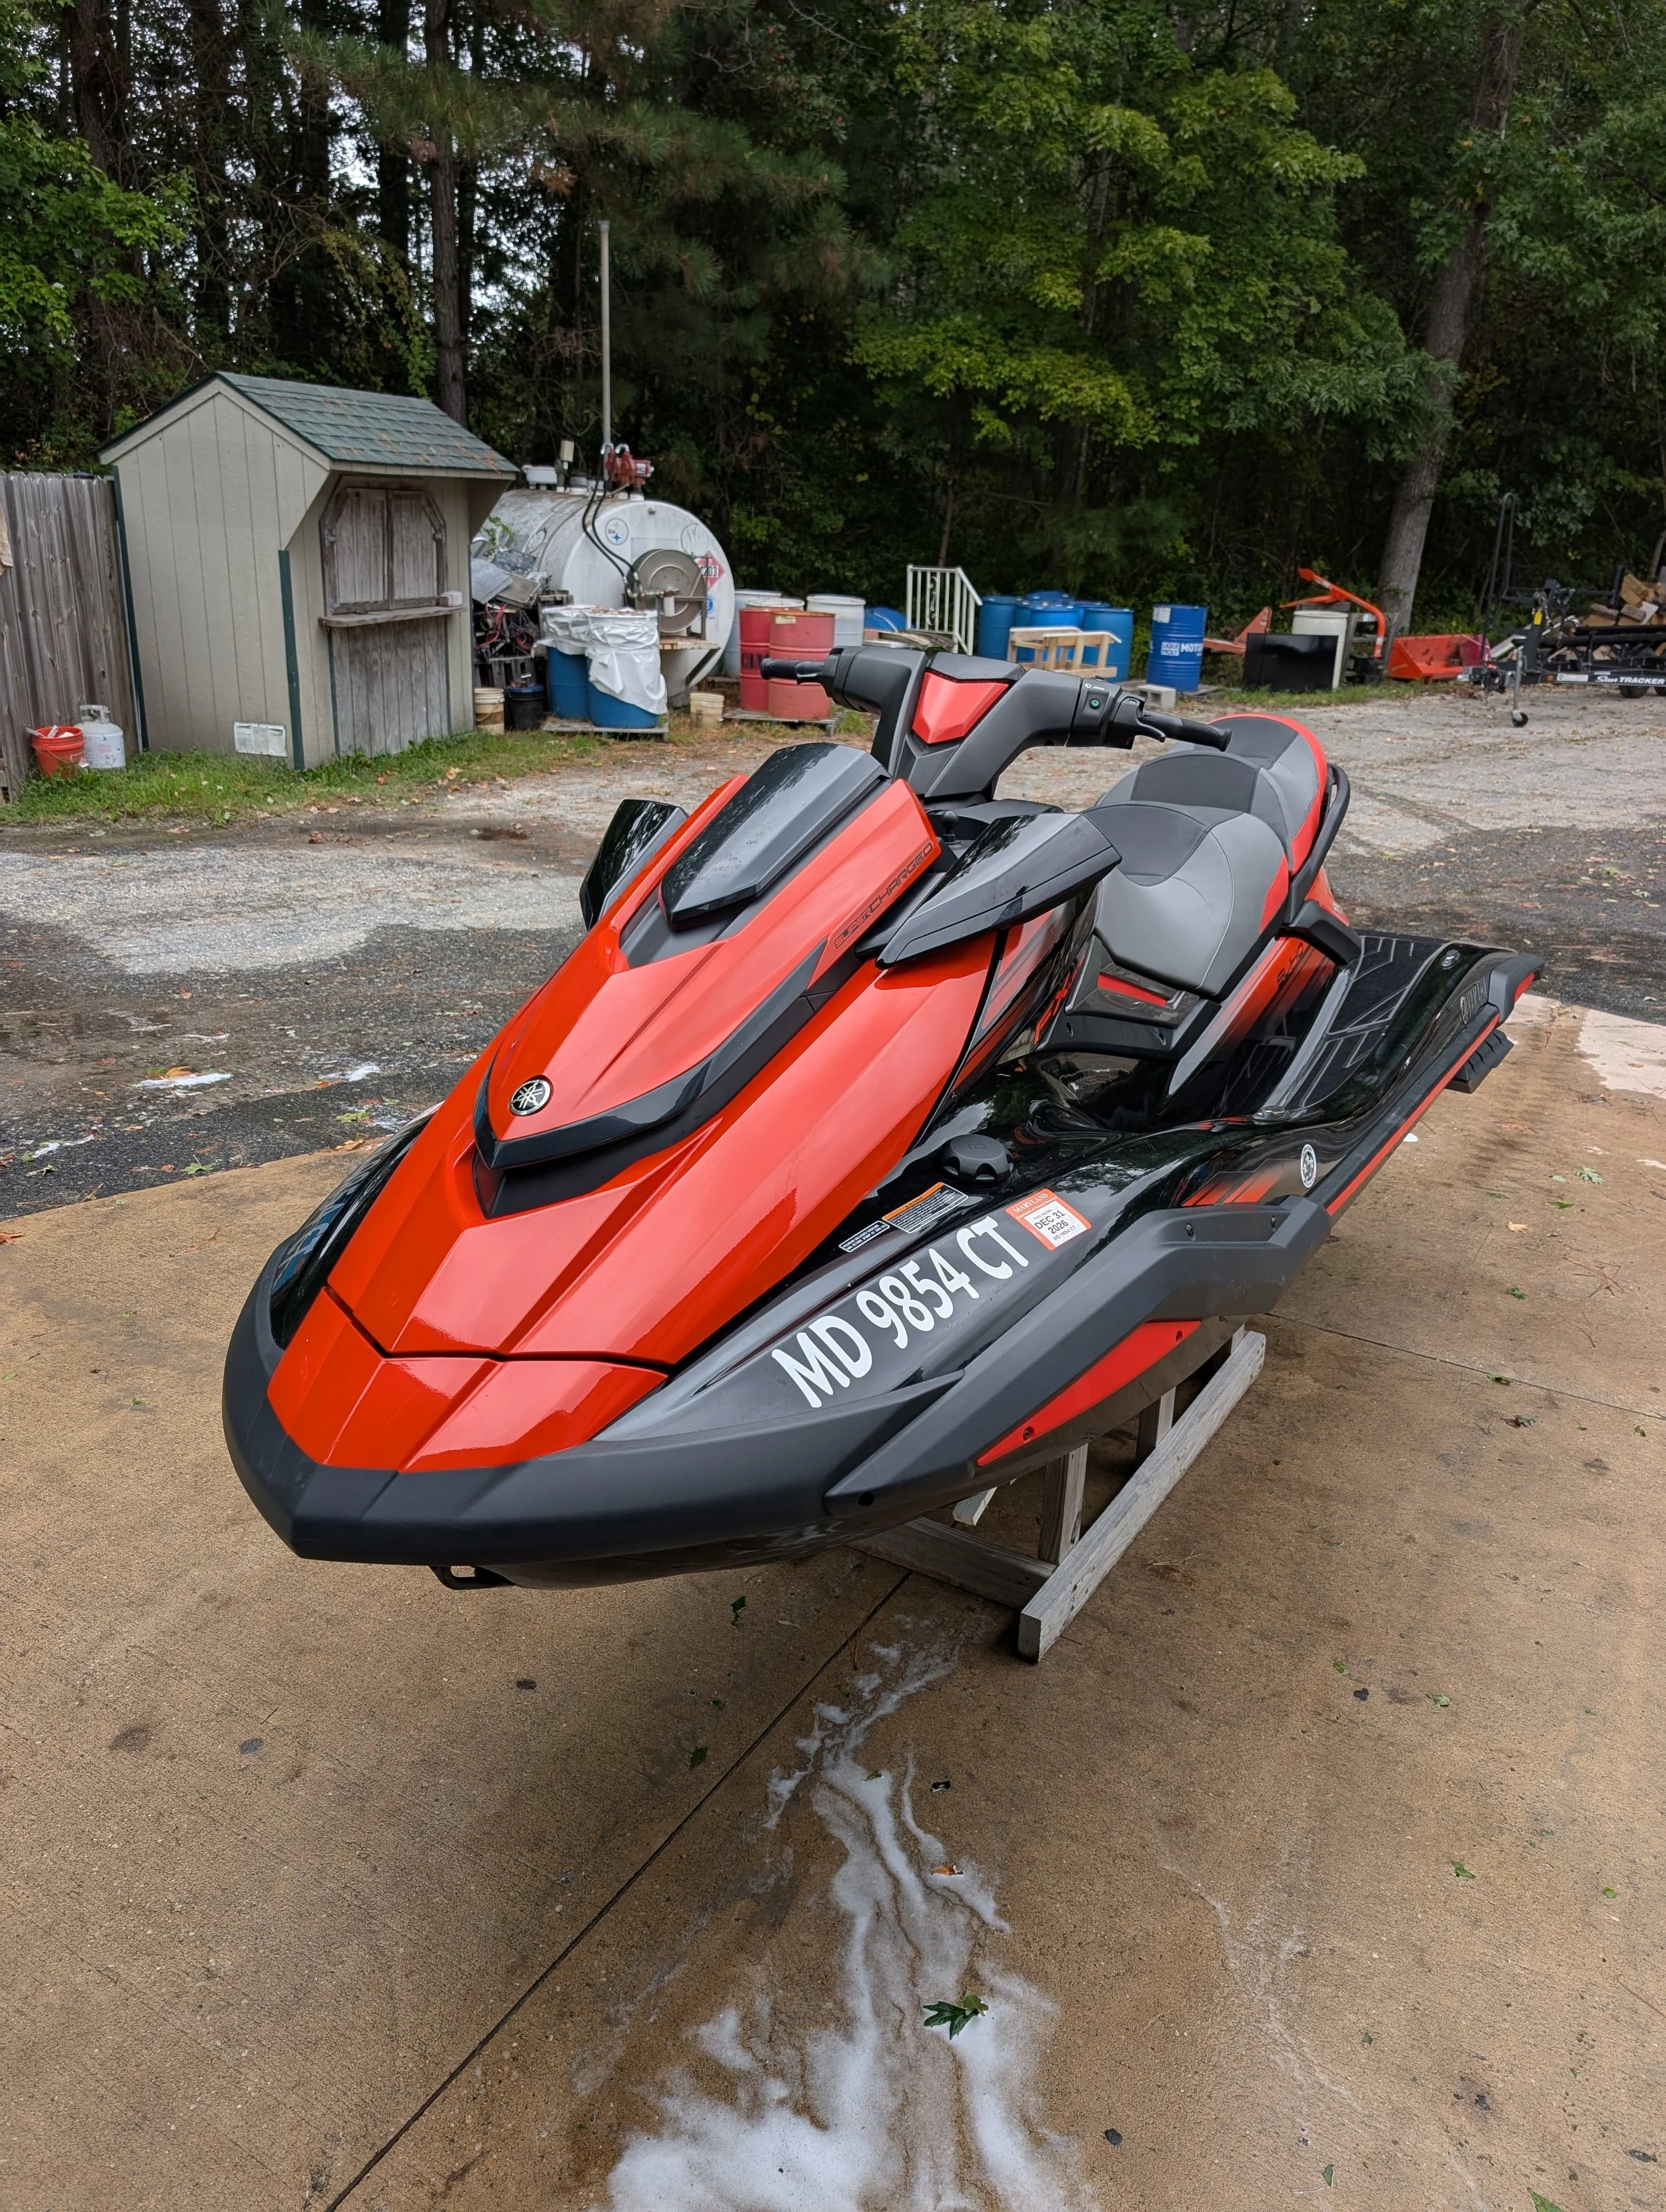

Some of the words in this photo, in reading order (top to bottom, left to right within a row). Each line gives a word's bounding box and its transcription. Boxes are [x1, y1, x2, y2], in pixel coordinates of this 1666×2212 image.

[701, 566, 717, 576] 203
[1180, 643, 1204, 652] MOTO
[1619, 676, 1665, 685] TRACKER
[834, 842, 933, 949] SUPERCHARGED
[1012, 1193, 1049, 1214] MARYLAND
[1034, 1216, 1055, 1229] DEC
[1053, 1210, 1066, 1219] 31
[1048, 1219, 1069, 1234] 2026
[772, 1315, 872, 1408] MD
[856, 1248, 980, 1349] 9854
[956, 1216, 1029, 1279] CT
